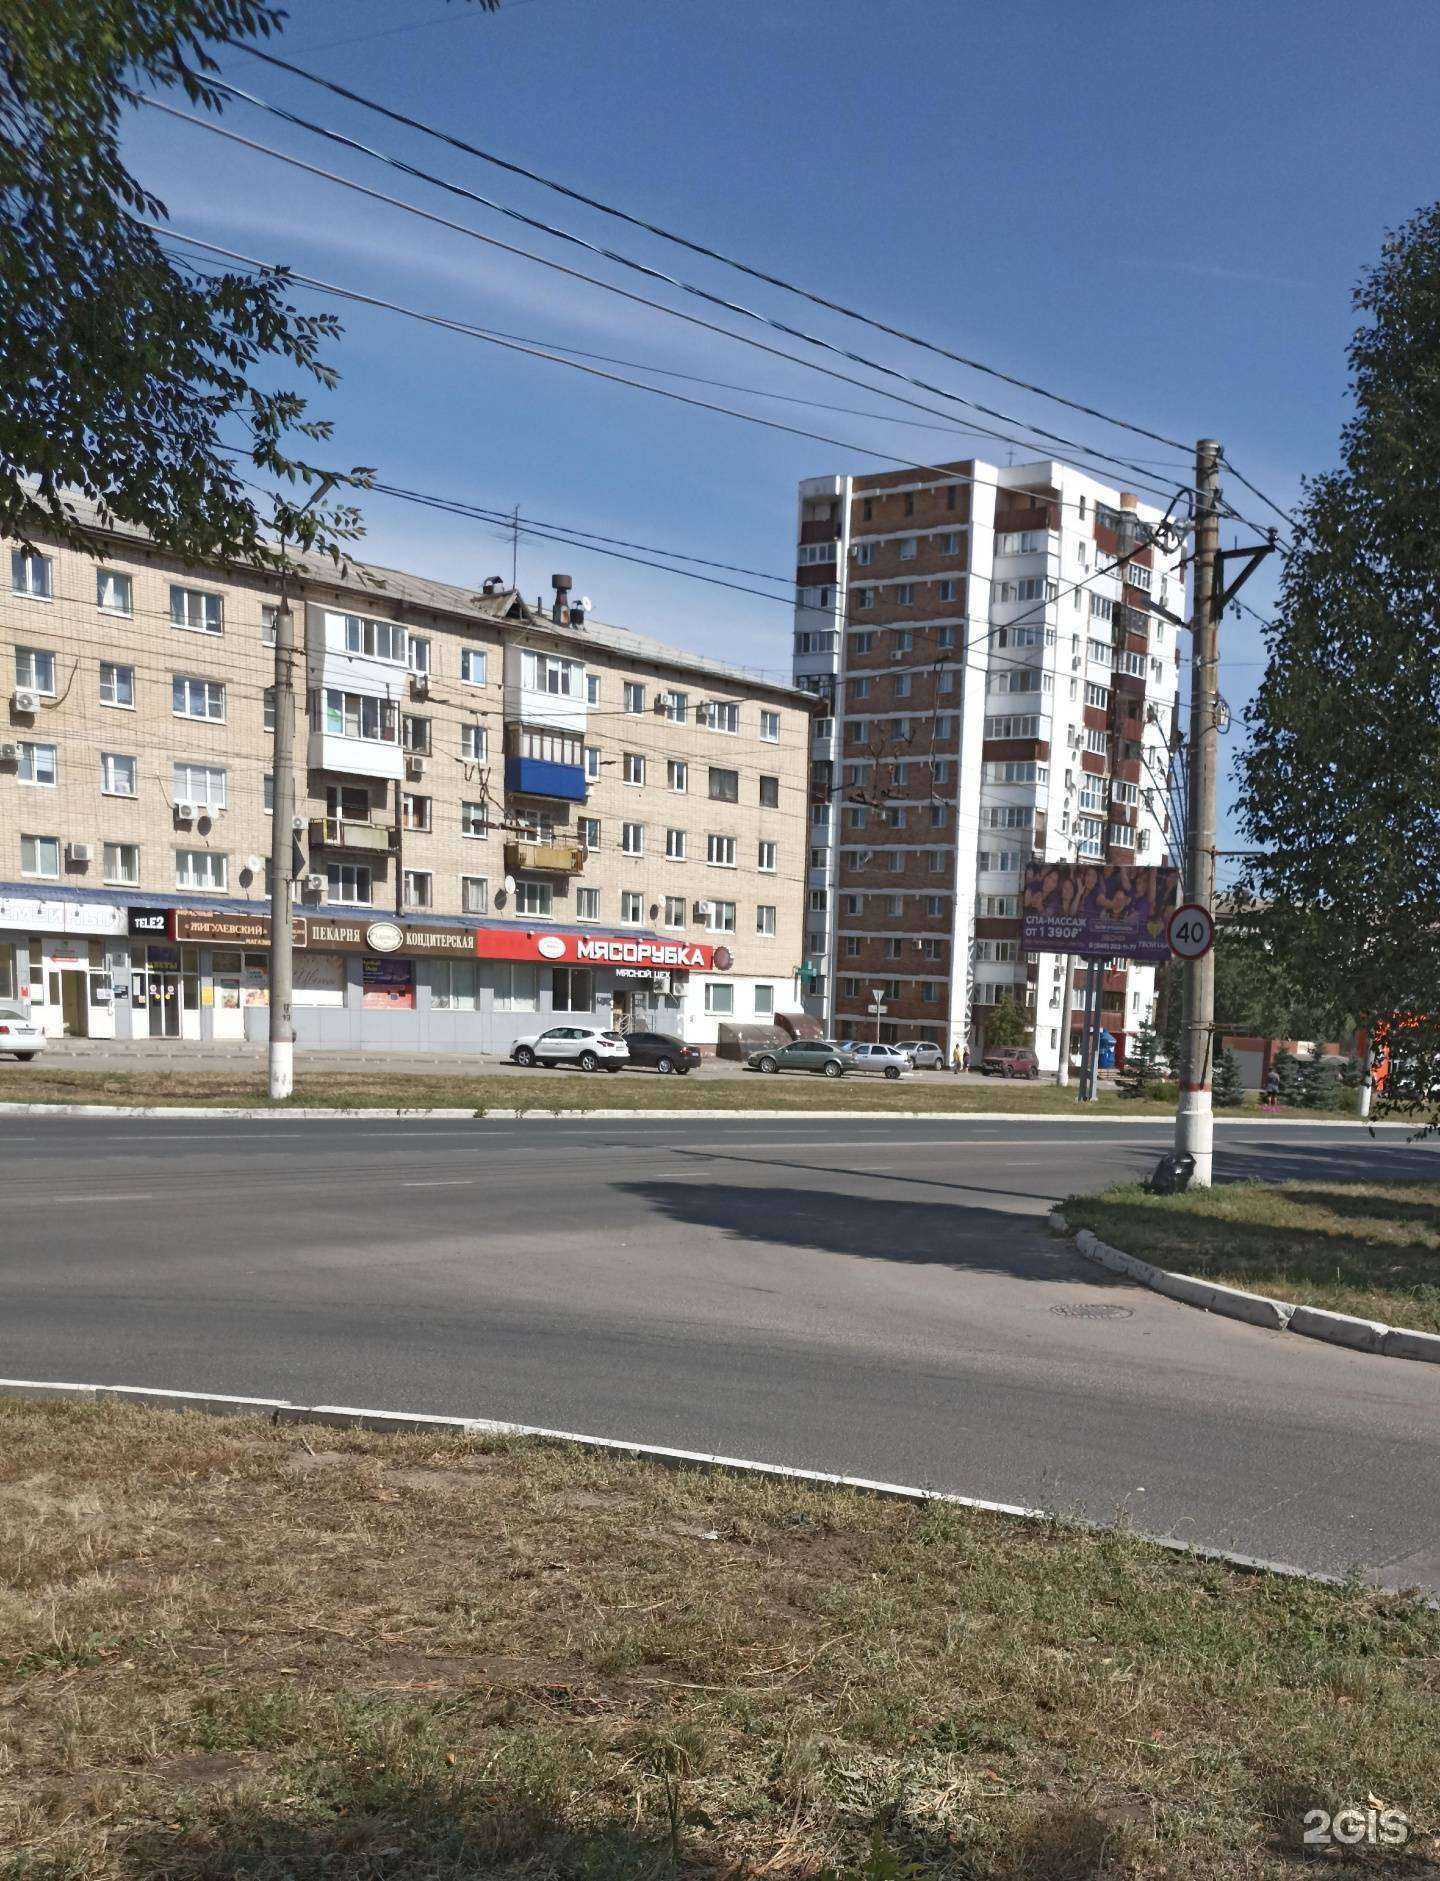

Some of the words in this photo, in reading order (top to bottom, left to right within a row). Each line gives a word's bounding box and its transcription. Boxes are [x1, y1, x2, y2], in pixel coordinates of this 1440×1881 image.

[135, 916, 165, 929] TELE2
[1025, 915, 1087, 927] СПА-МАССАЖ
[312, 926, 361, 943] ПЕКАРНЯ
[1025, 927, 1037, 937] ОТ
[1176, 922, 1204, 943] 40
[406, 931, 474, 950] КОНДИТЕРСКАЯ
[577, 940, 704, 966] МЯСОРУБКА
[616, 968, 651, 979] МЯСНОЙ
